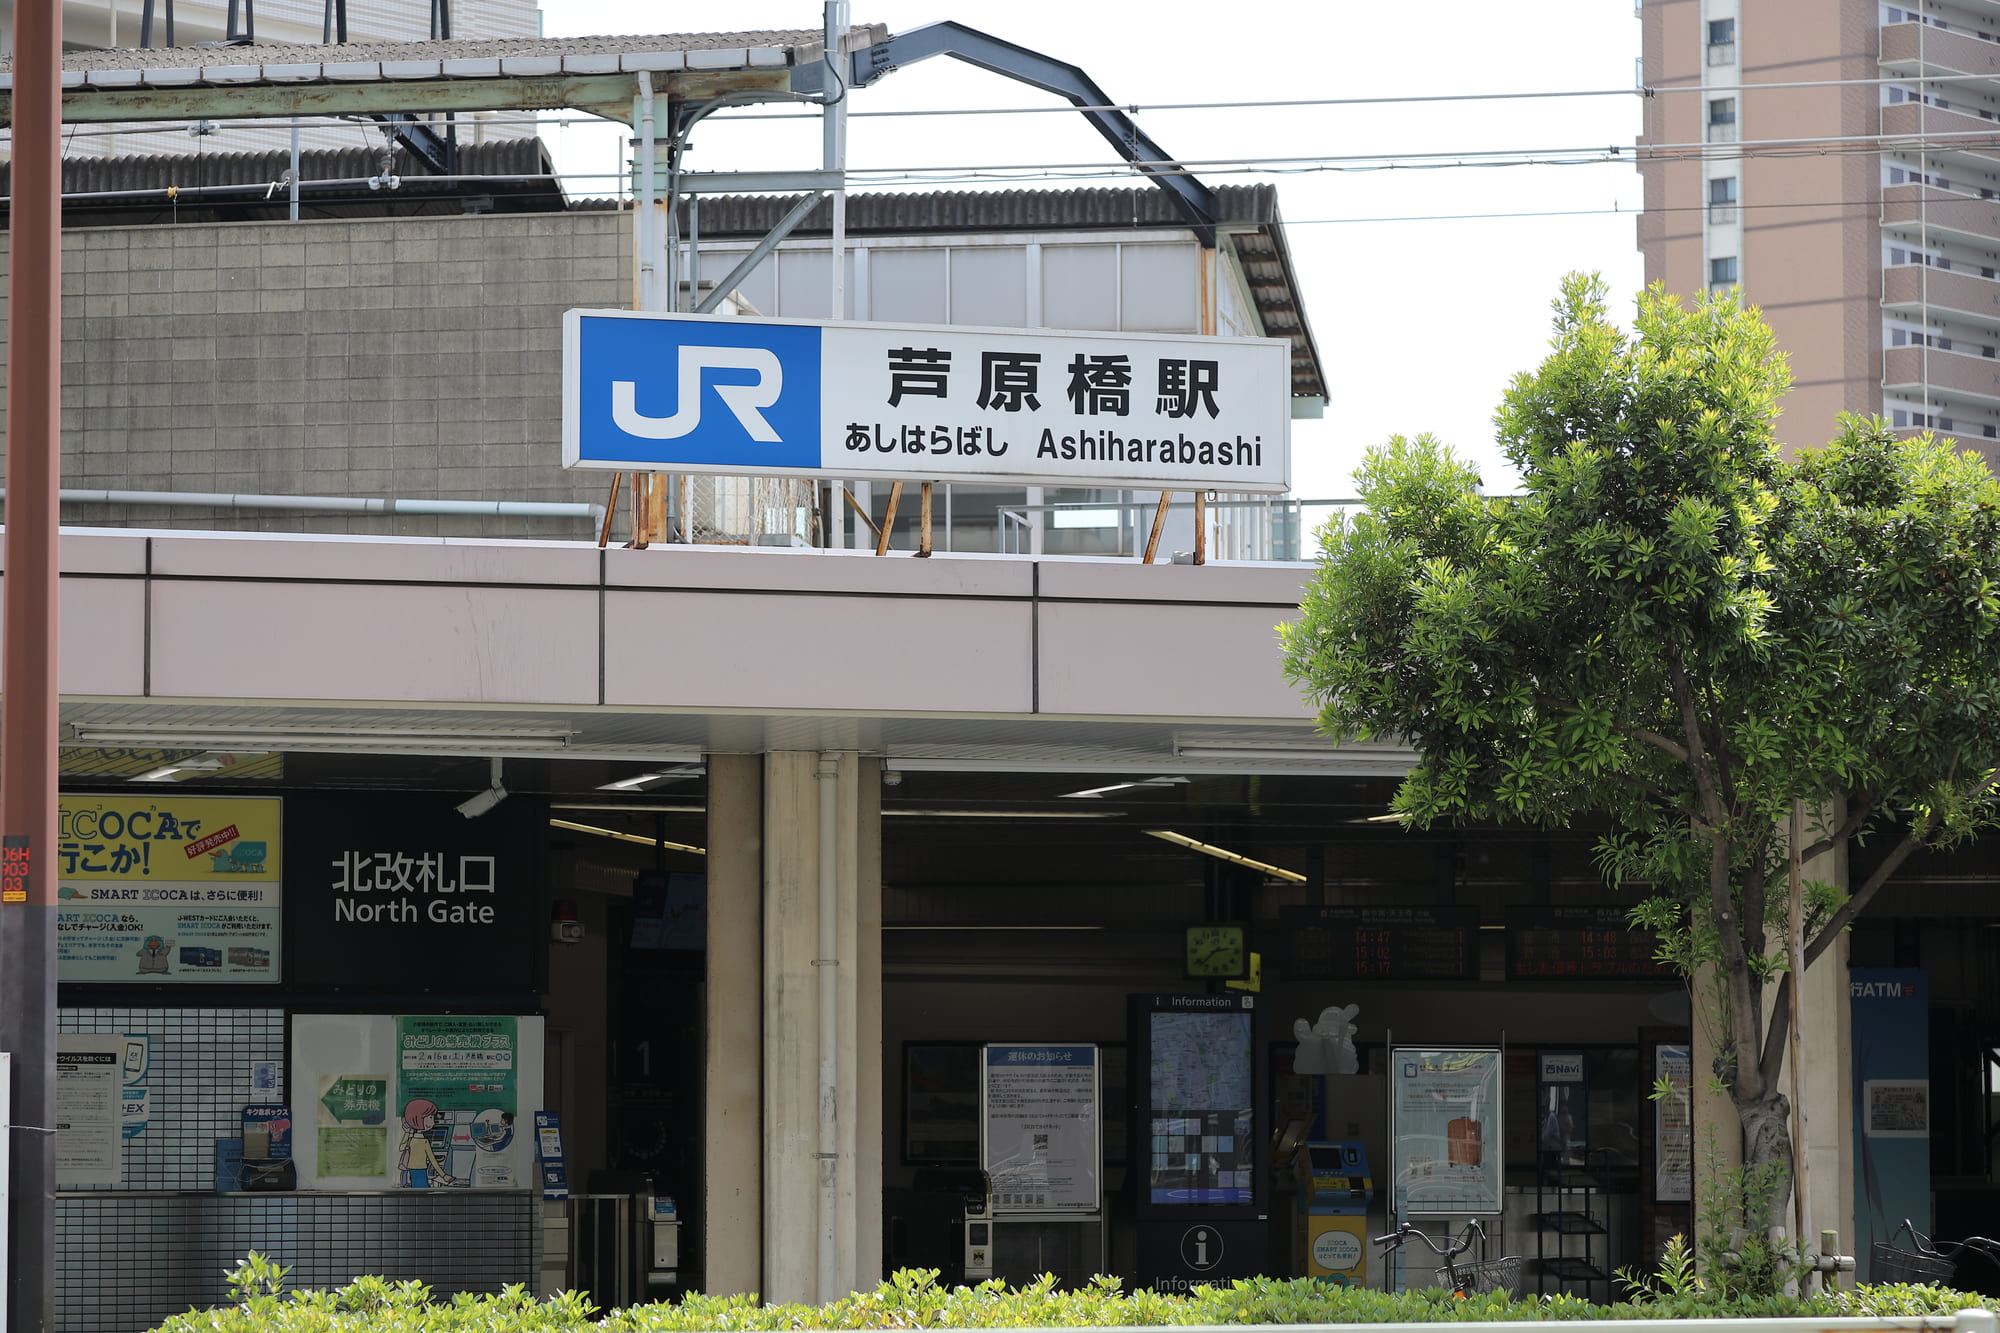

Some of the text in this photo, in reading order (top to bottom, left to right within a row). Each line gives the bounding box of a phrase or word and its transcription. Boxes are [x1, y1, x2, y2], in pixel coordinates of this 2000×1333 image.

[612, 345, 783, 443] JR
[887, 346, 1220, 421] 芦原橋駅
[845, 422, 1262, 468] あしはらばし Ashiharabashi
[331, 850, 495, 894] 北改札口
[90, 889, 139, 900] SMART
[335, 897, 495, 924] North Gate
[1355, 931, 1390, 944] 14:47
[1172, 995, 1232, 1007] Information
[333, 1084, 377, 1096] みどりの
